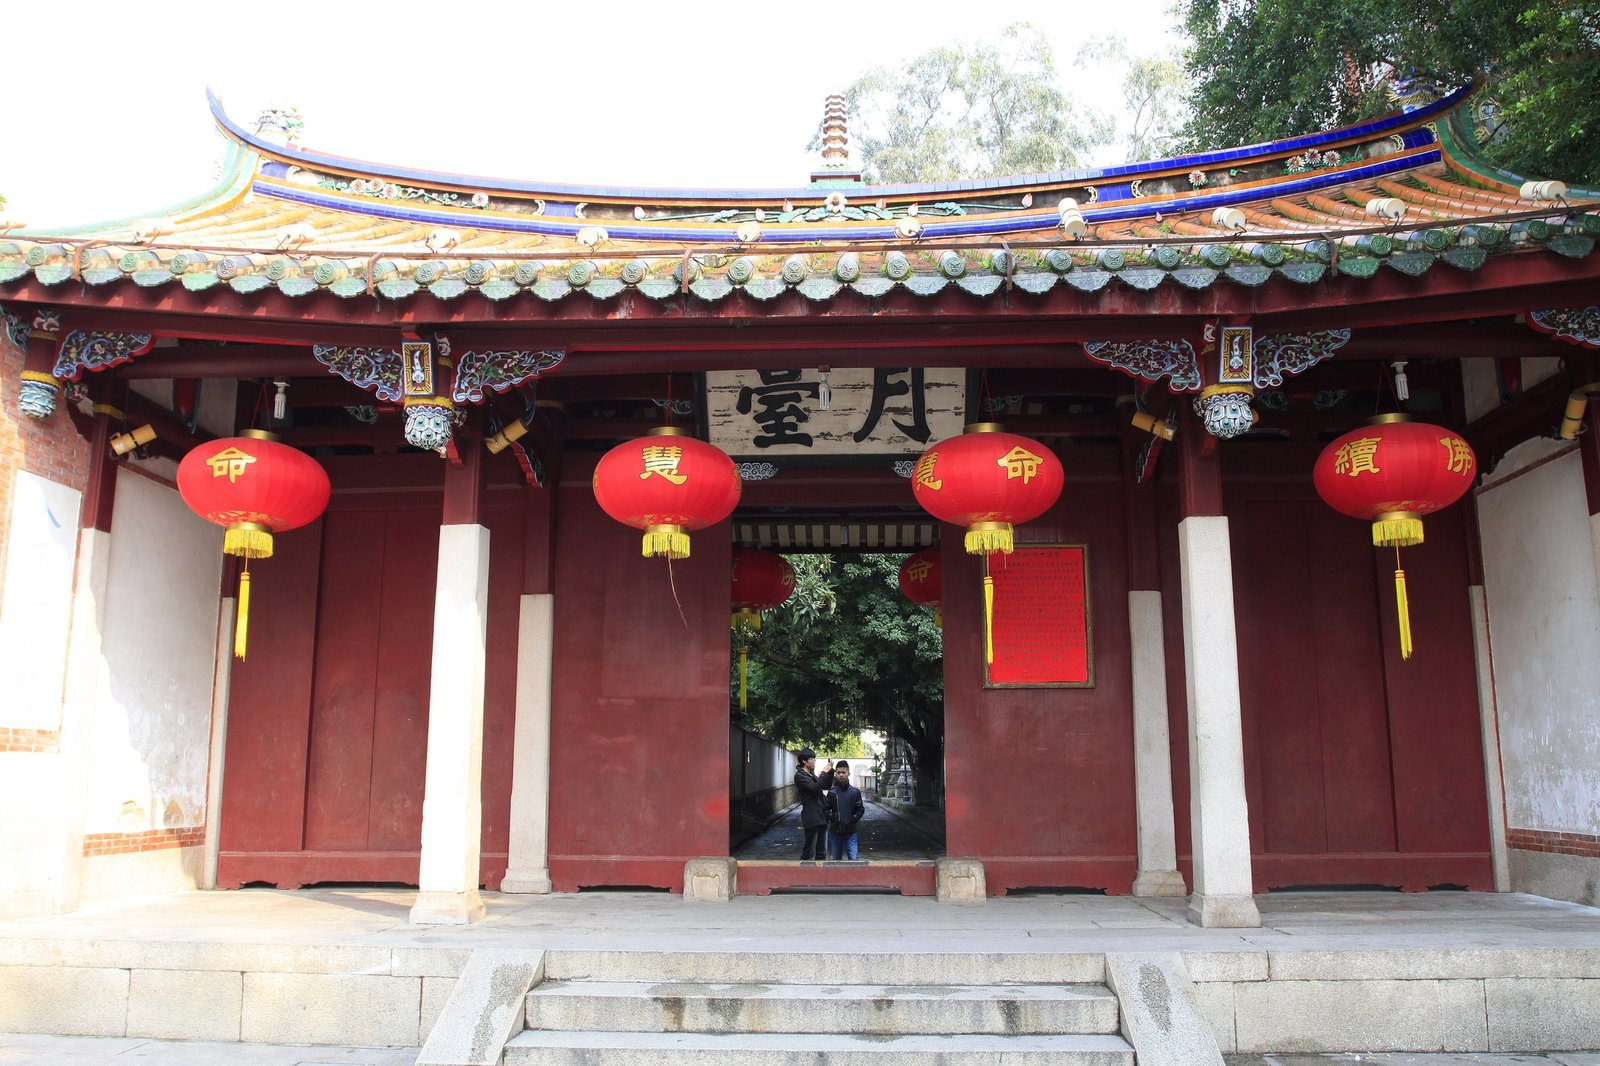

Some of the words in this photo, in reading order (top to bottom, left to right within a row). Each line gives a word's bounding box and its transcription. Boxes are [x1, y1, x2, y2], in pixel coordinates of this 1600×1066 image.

[205, 446, 257, 483] 命
[639, 445, 688, 485] 慧
[997, 445, 1044, 485] 命
[1334, 437, 1382, 477] 續
[1440, 437, 1473, 477] 佛
[906, 558, 934, 584] 命
